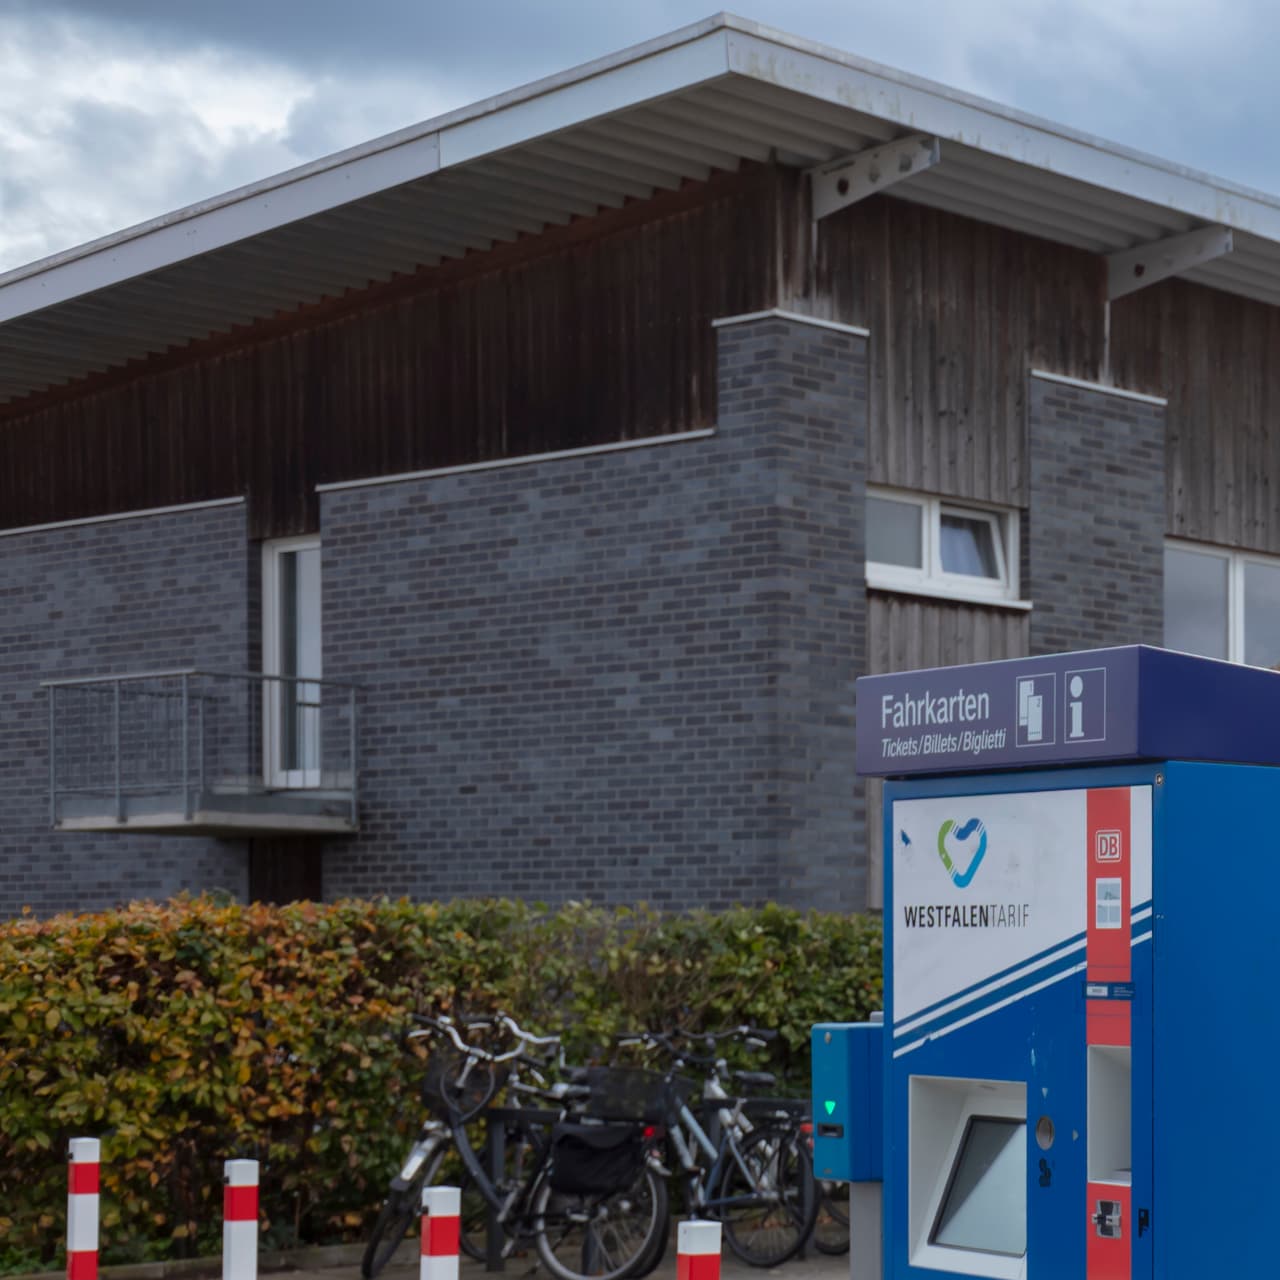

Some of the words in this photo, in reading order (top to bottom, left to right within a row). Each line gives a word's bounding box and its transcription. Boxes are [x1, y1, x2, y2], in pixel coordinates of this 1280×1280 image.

[881, 688, 990, 729] Fahrkarten
[1099, 835, 1118, 857] DB
[903, 904, 1030, 929] WESTFALENTARIF
